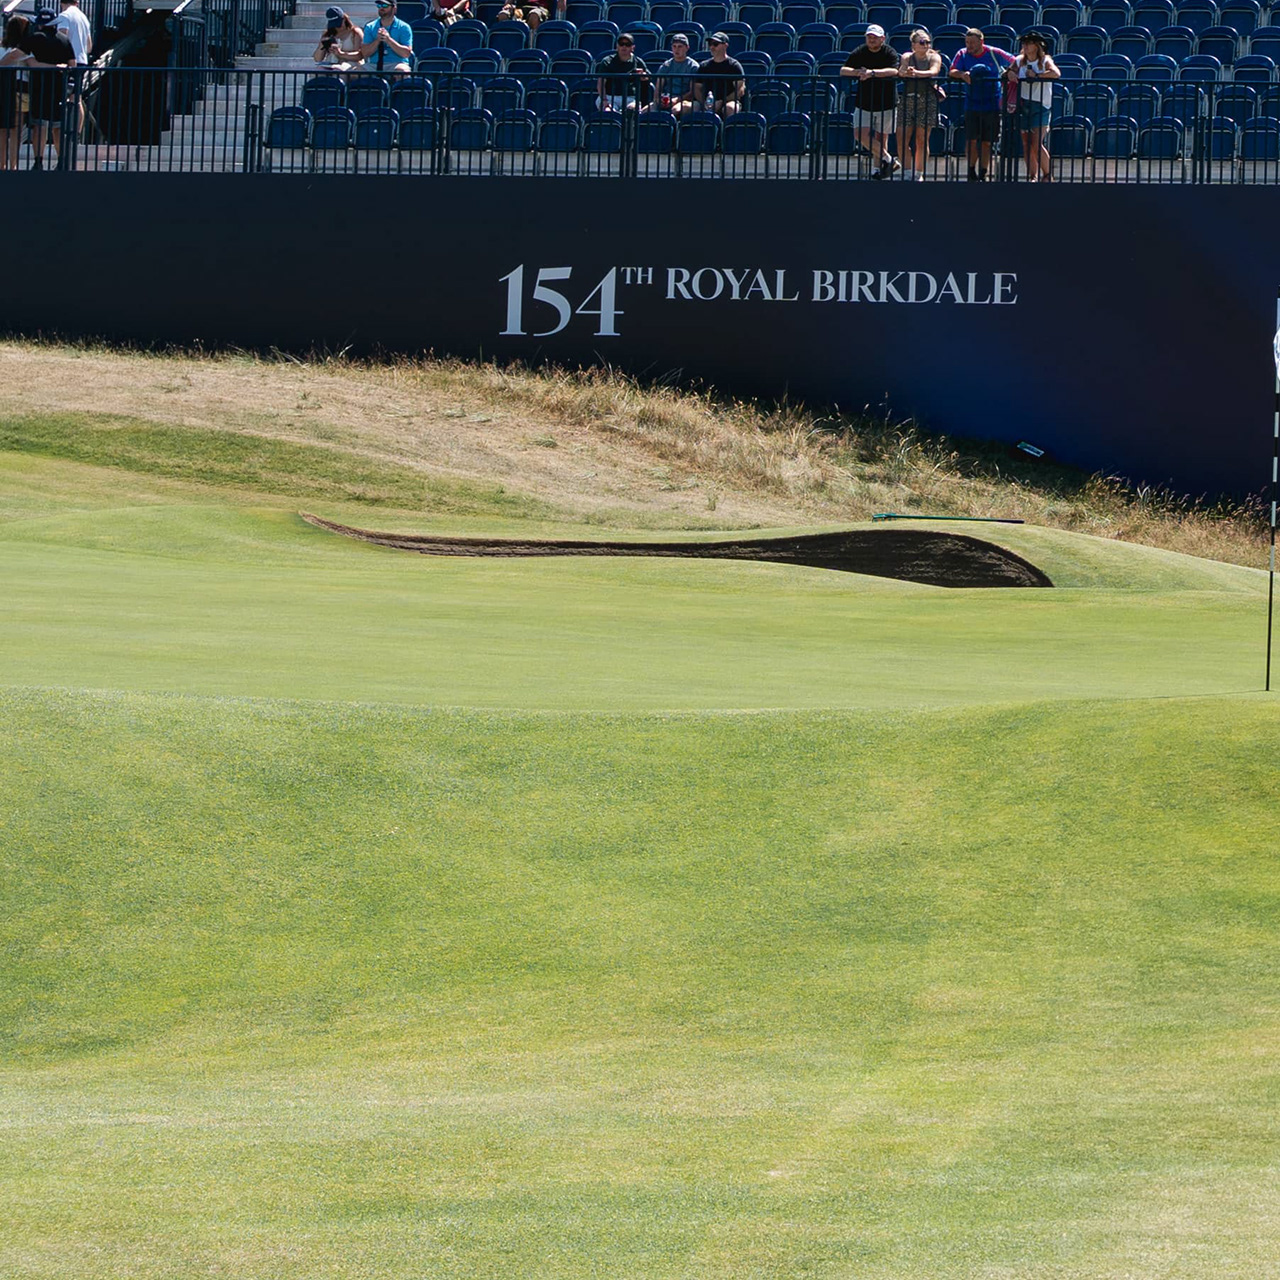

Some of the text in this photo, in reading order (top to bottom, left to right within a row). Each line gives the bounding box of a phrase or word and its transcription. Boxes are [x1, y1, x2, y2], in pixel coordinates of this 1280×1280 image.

[498, 264, 1018, 336] 154TH ROYAL BIRKDALE
